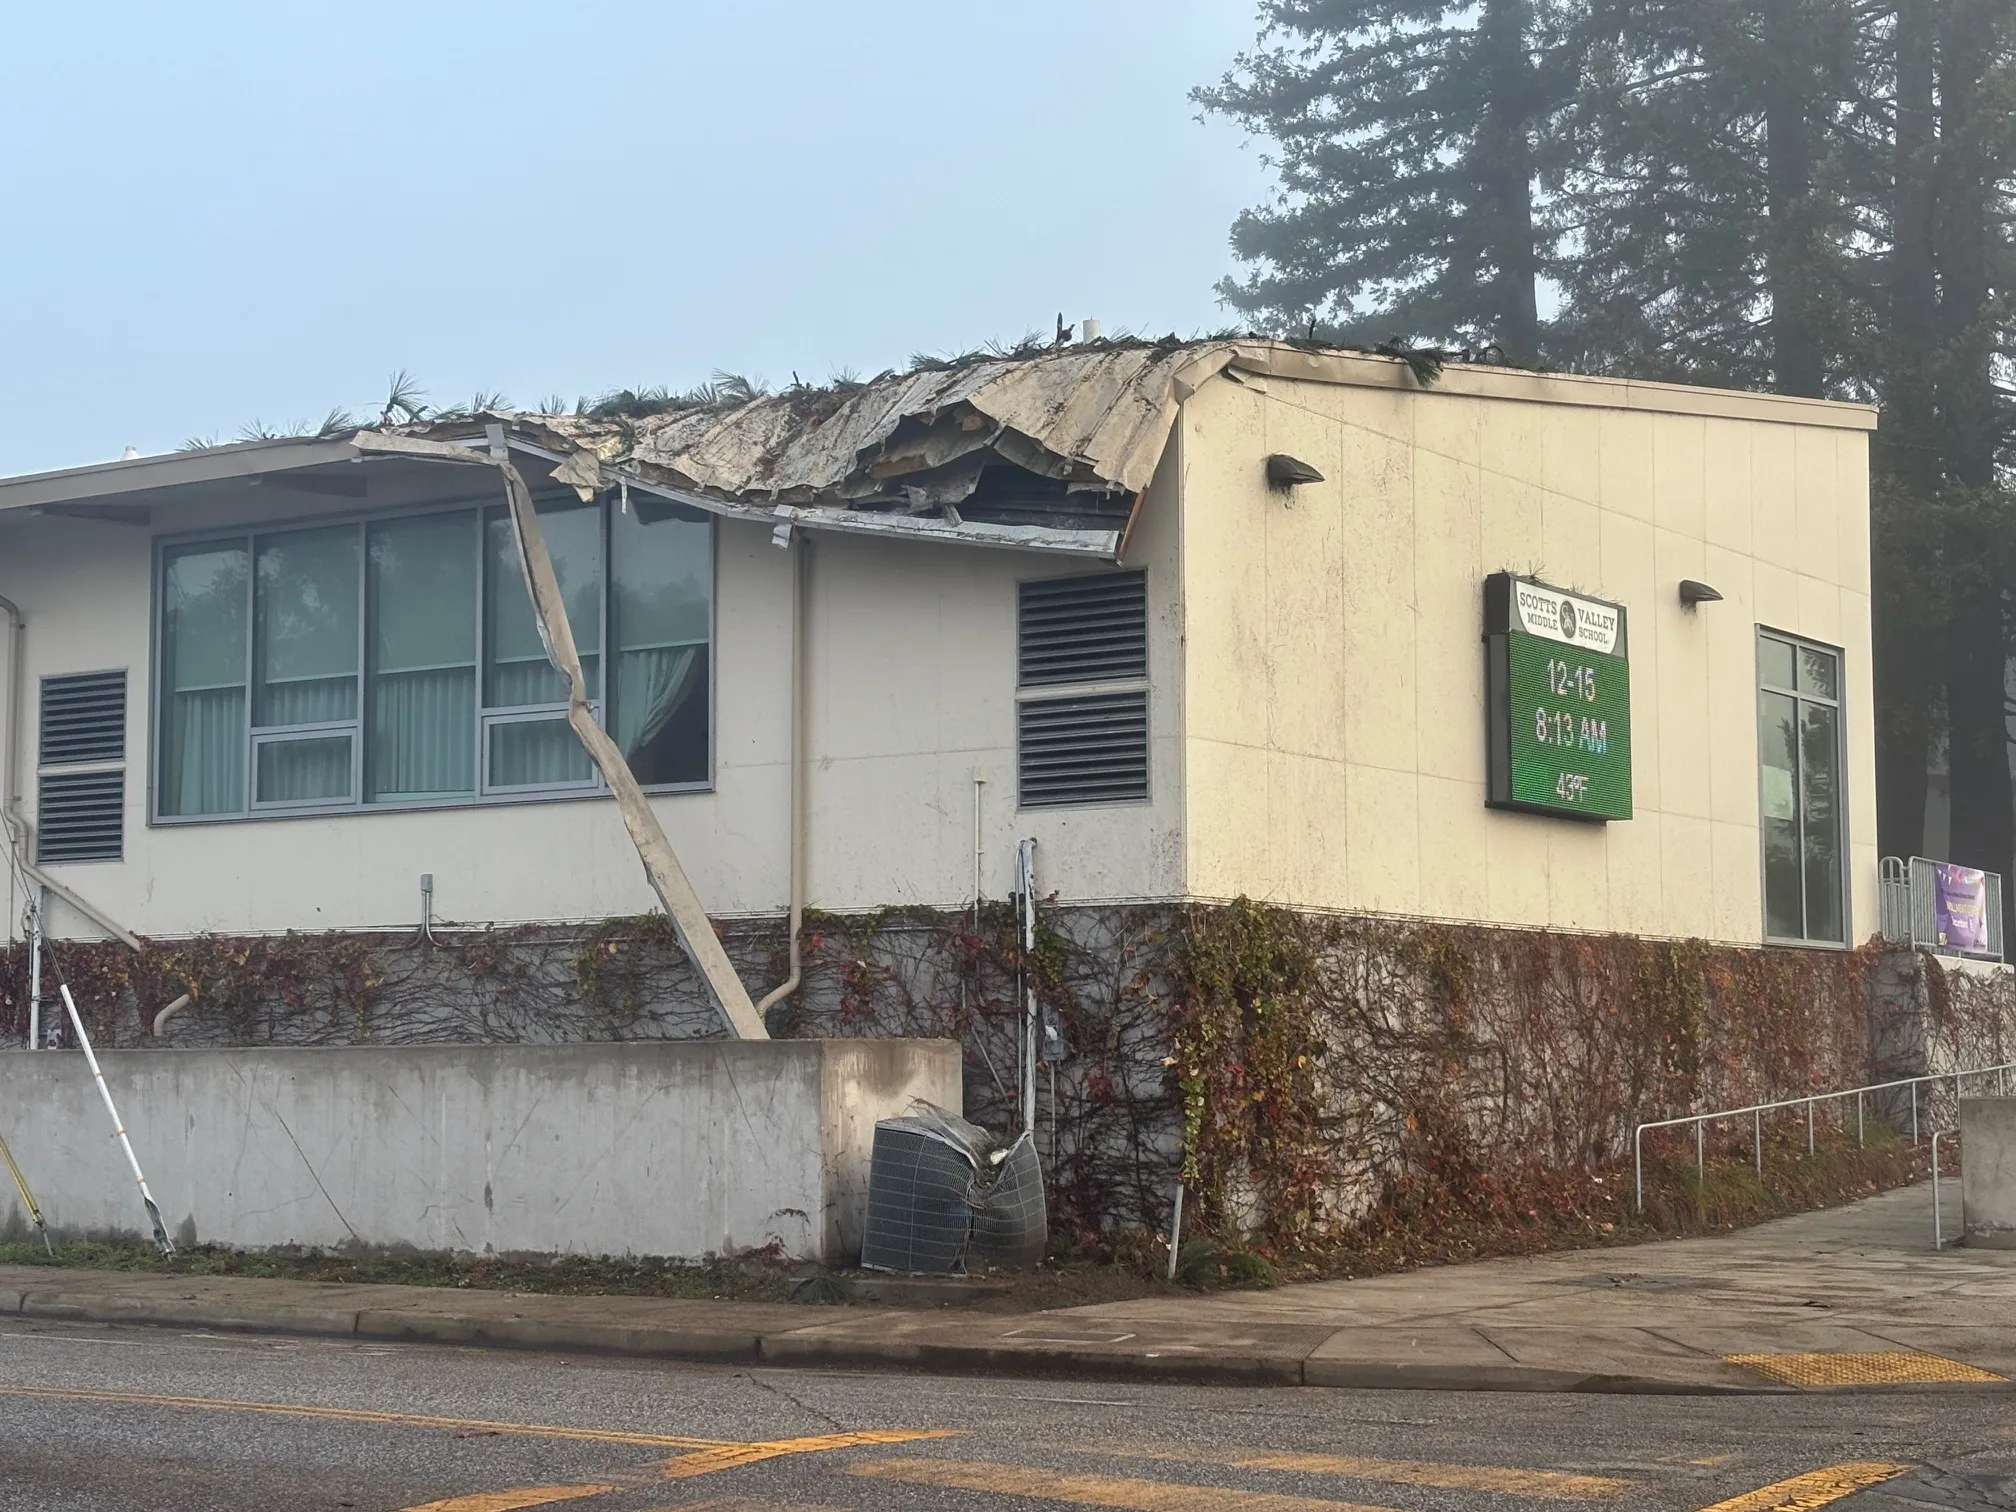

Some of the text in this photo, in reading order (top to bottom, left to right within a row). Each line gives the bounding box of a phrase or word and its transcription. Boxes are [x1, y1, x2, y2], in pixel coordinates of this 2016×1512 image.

[1520, 592, 1615, 631] SCOTTS VALLEY
[1527, 612, 1608, 644] MIDDLE SCHOOL
[1547, 659, 1596, 702] 12-15
[1536, 706, 1607, 754] 8:13 AM
